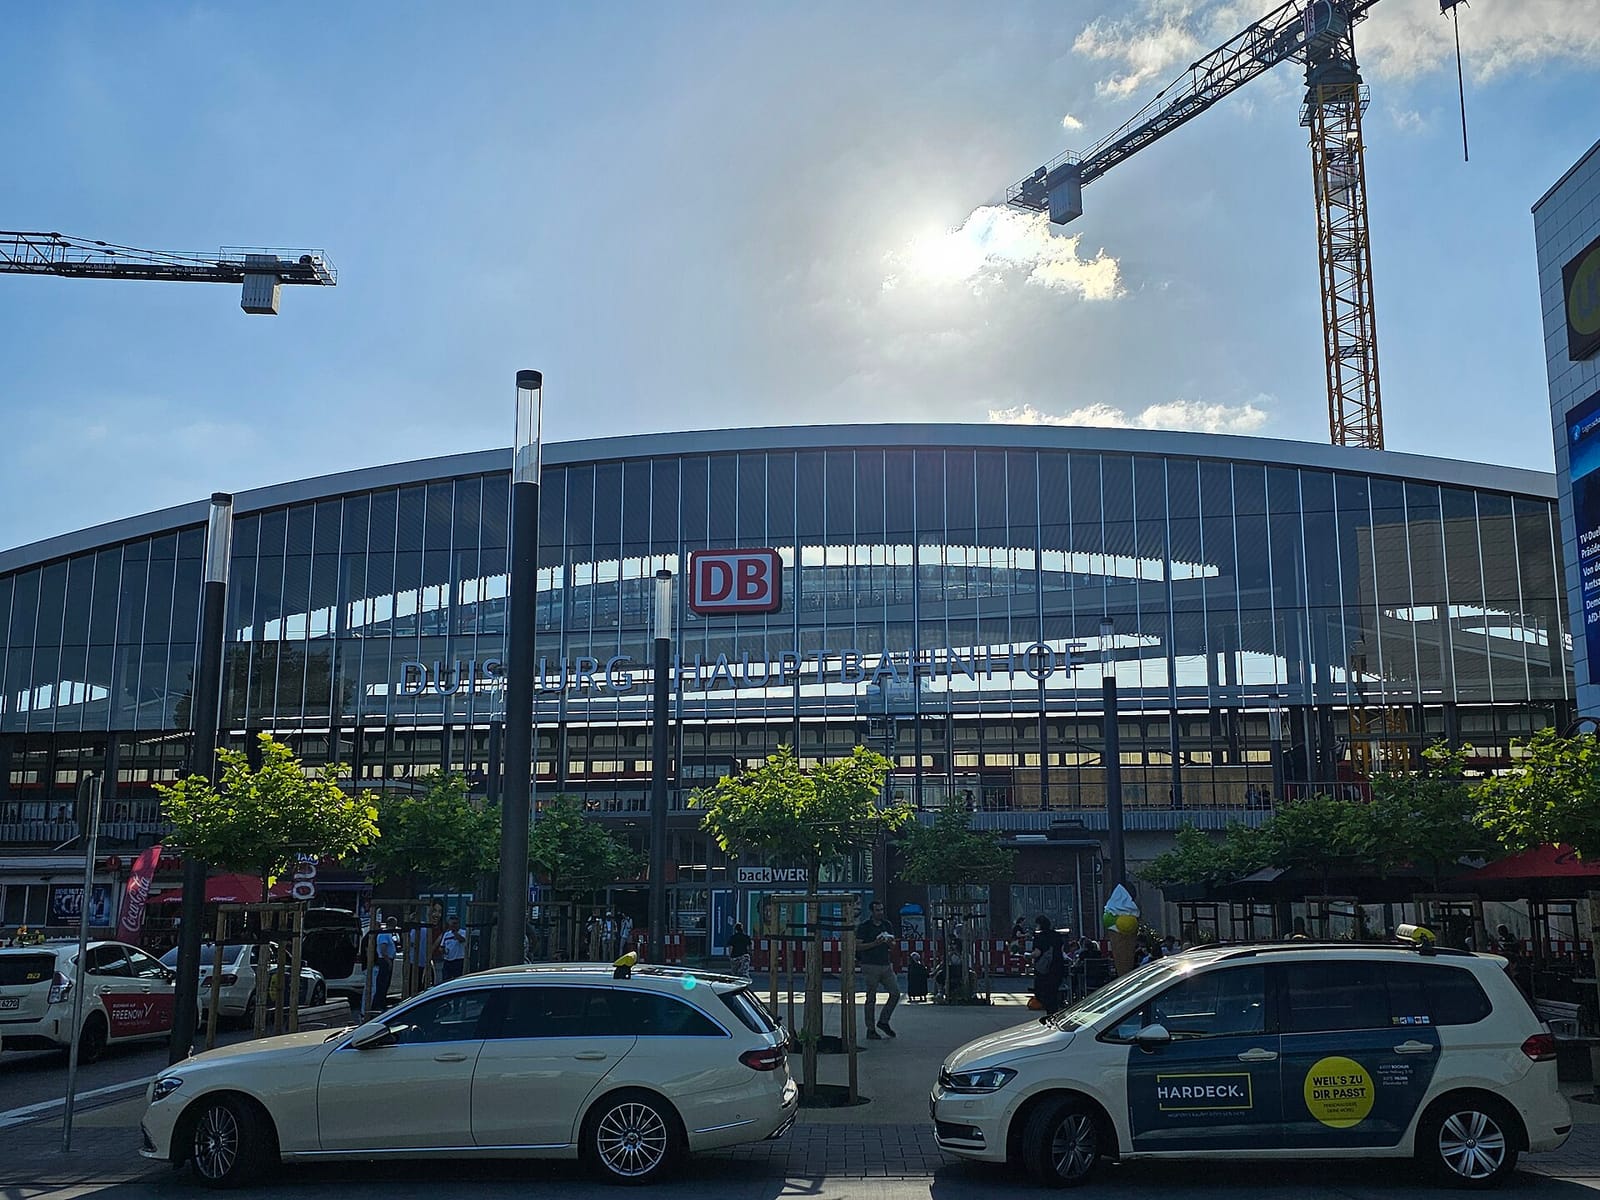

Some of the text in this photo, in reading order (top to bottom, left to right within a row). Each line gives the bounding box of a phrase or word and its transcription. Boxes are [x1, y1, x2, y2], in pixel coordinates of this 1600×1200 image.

[701, 558, 768, 602] DB
[399, 642, 1088, 697] DUISURG HAUPTBAHNHOF
[112, 1009, 144, 1020] FREENOW
[1313, 1075, 1363, 1086] WEIL'S ZU
[1157, 1085, 1244, 1099] HARDECK.
[1313, 1088, 1366, 1099] DIR PASST
